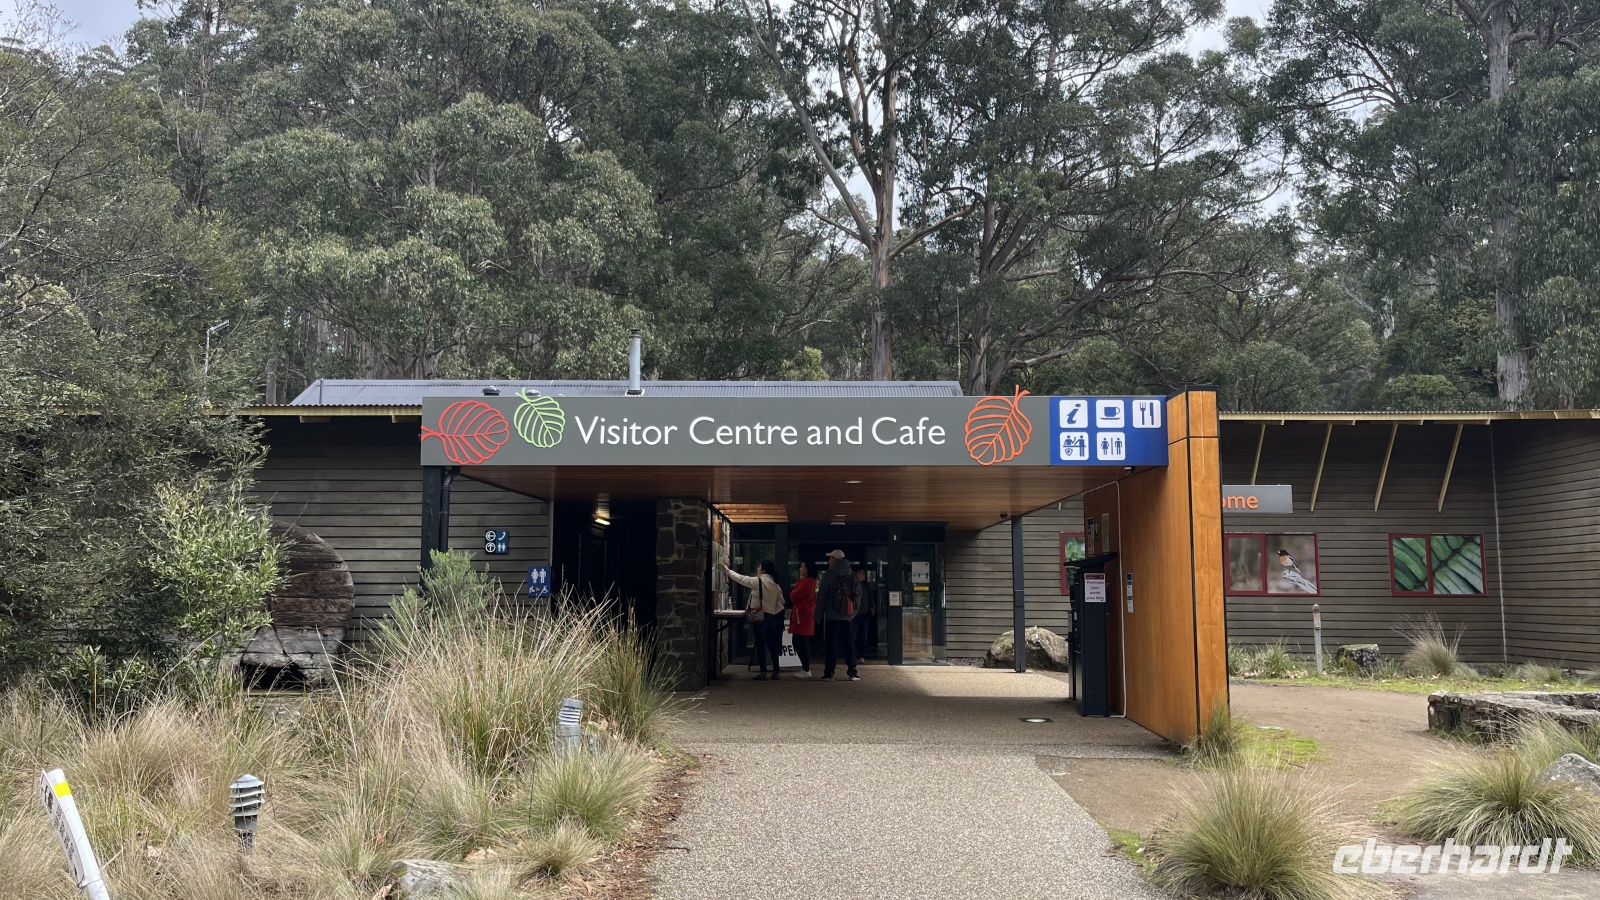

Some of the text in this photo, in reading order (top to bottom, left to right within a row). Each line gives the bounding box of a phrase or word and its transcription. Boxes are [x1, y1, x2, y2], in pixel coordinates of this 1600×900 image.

[574, 415, 946, 445] Visitor Centre and Cafe
